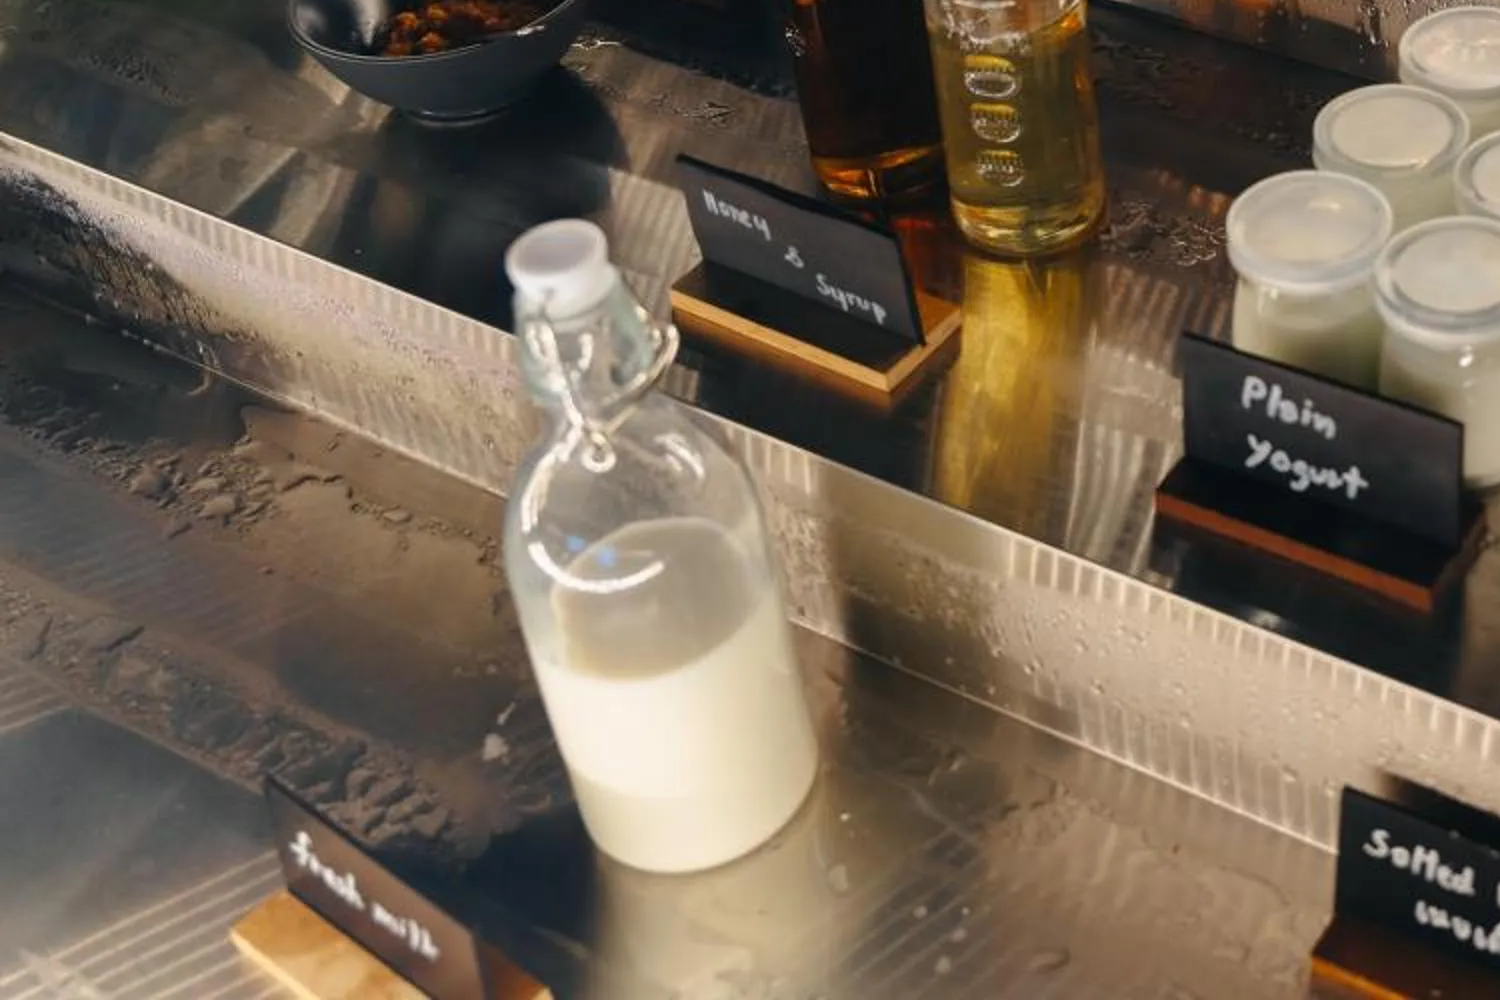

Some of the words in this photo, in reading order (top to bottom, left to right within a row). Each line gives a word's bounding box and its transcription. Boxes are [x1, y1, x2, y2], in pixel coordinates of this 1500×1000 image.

[703, 188, 772, 242] Honey
[815, 272, 887, 326] Syrup
[1241, 375, 1337, 440] Plain
[1362, 828, 1476, 896] Salted
